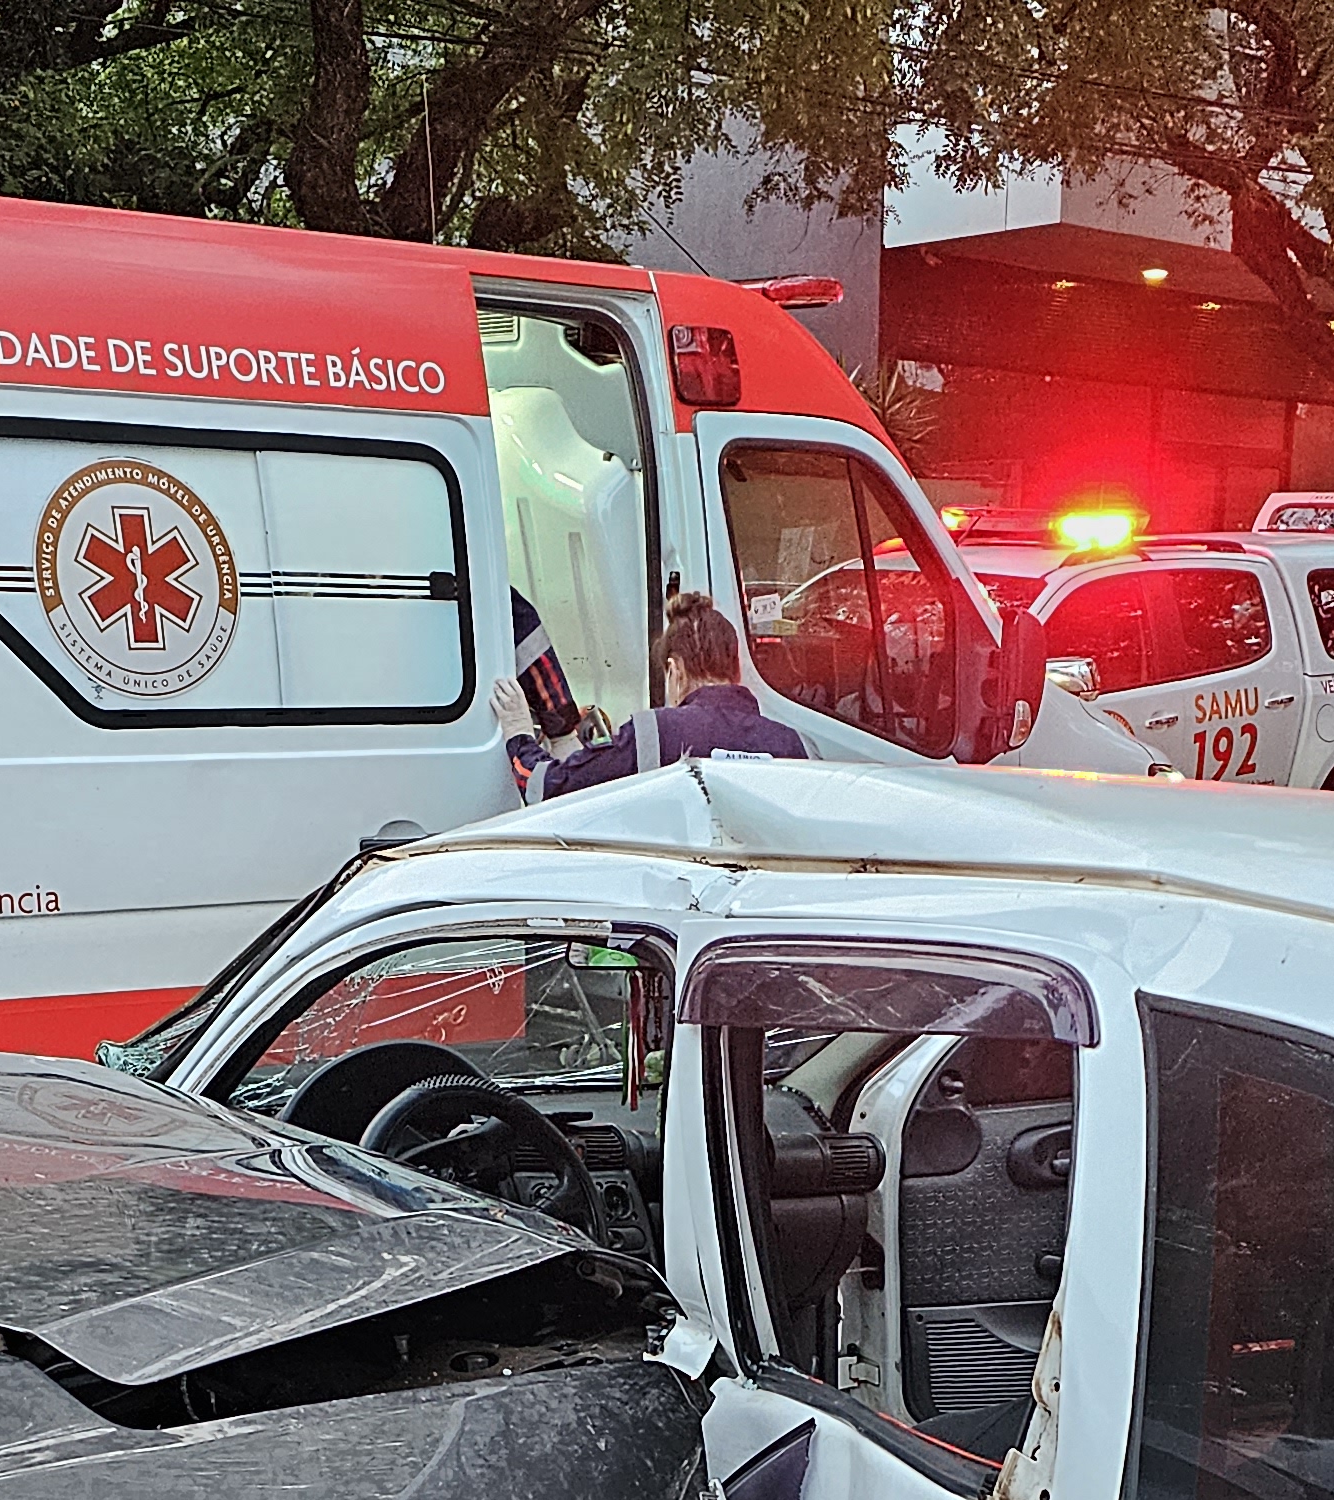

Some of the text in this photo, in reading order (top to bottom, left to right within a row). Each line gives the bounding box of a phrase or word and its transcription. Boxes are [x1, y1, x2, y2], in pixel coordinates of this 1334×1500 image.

[107, 339, 157, 375] DE
[164, 343, 321, 387] SUPORTE
[327, 346, 446, 394] BÁSICO
[41, 466, 234, 600] SERVIÇO DE ATENDIMENTO MÓVEL DE URGÊNCIA
[58, 623, 228, 689] SISTEMA ÚNICO DE SAÚDE
[1194, 686, 1260, 725] SAMU
[1193, 722, 1258, 781] 192
